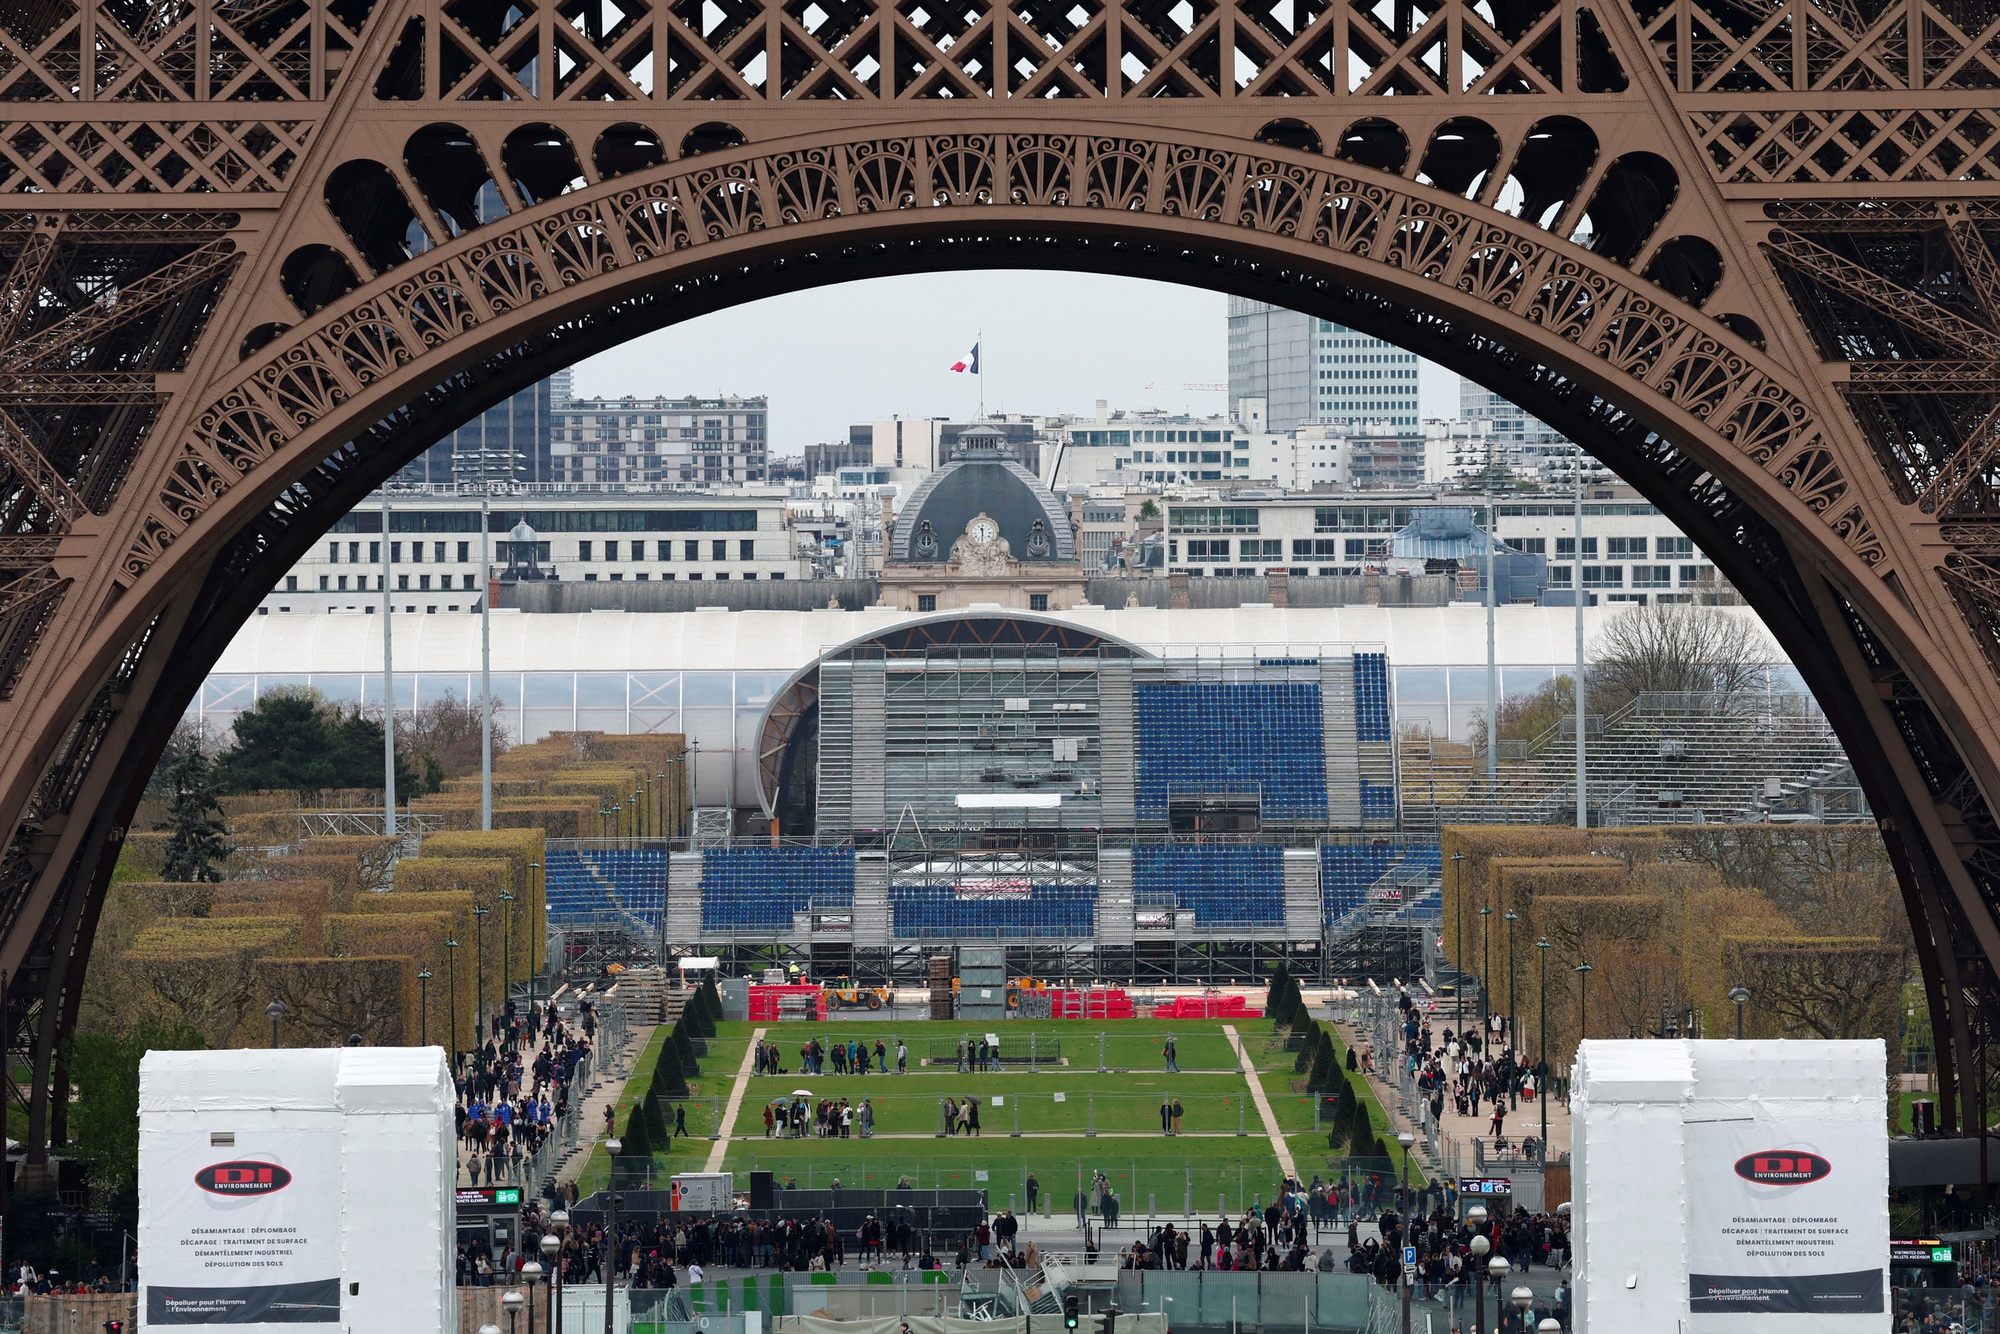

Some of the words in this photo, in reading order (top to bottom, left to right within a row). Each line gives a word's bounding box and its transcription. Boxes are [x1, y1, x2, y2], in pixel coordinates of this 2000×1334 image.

[1754, 1157, 1812, 1172] DI
[214, 1168, 273, 1183] DI
[1792, 1215, 1838, 1223] DÉPLOMBAGE
[251, 1226, 297, 1234] DÉPLOMBAGE
[1407, 1250, 1413, 1261] P
[1708, 1288, 1741, 1296] Dépolluer
[1741, 1289, 1758, 1297] pour
[165, 1299, 198, 1307] Dépolluer
